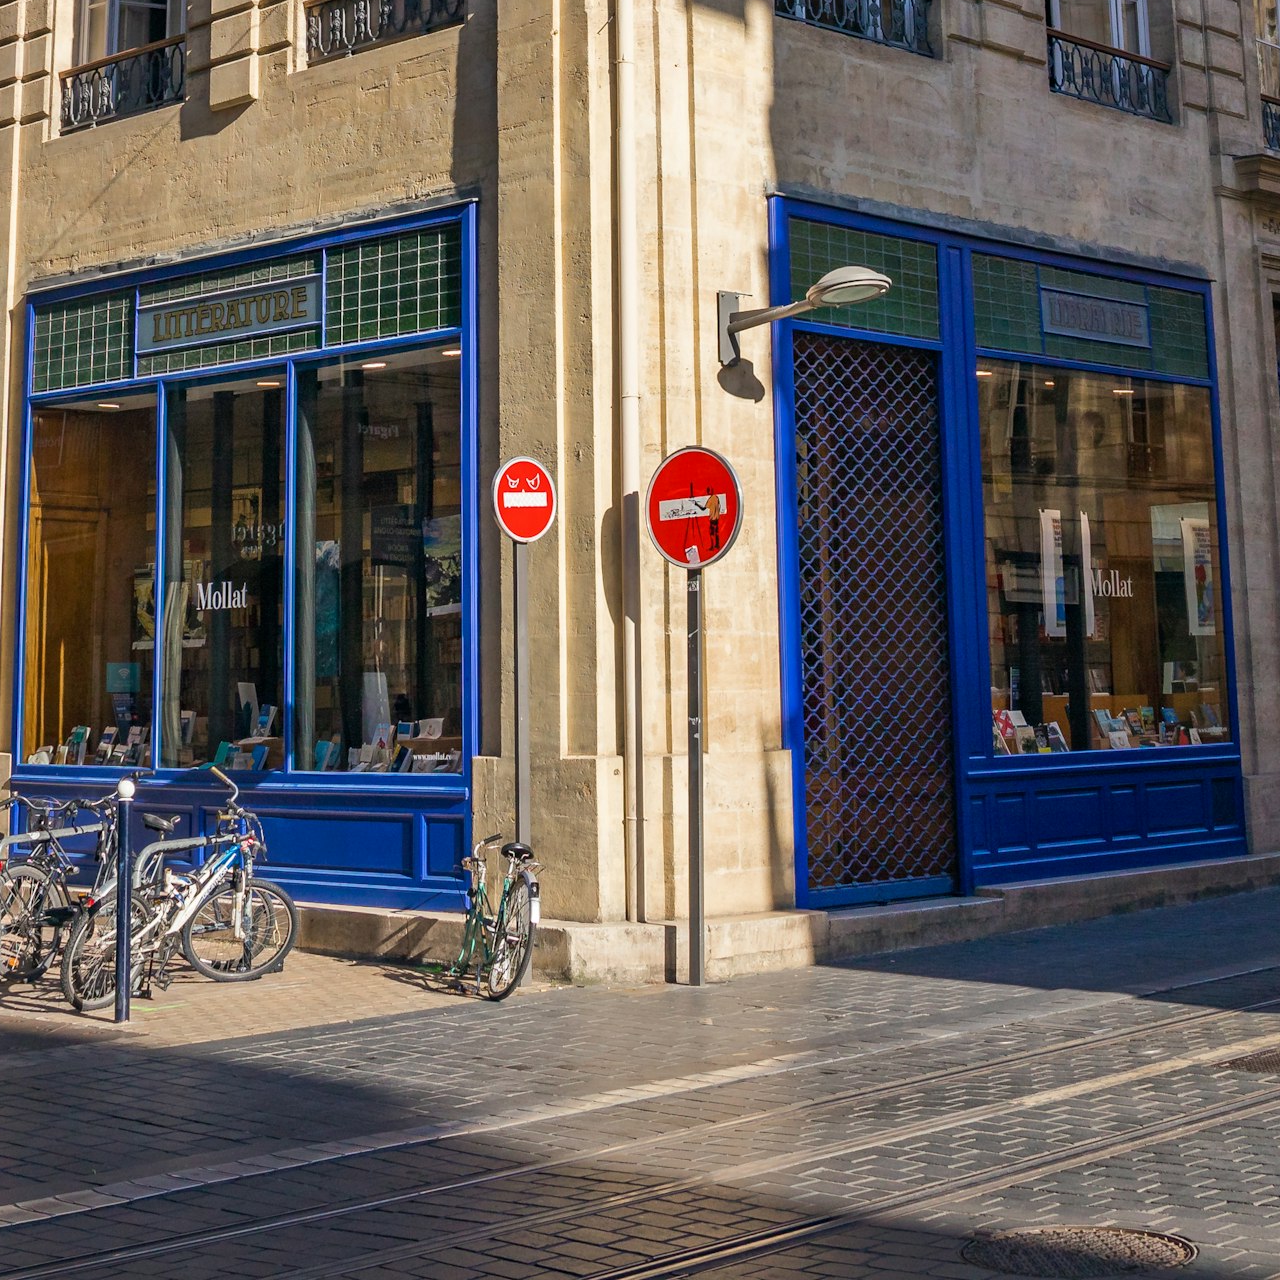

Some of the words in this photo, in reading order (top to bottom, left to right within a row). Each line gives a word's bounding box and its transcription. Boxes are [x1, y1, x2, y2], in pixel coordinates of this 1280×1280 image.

[152, 286, 308, 342] LITTÉRATURE
[1049, 296, 1143, 339] LIBRAIRIE
[196, 581, 248, 610] Mollat
[1091, 569, 1134, 598] Mollat
